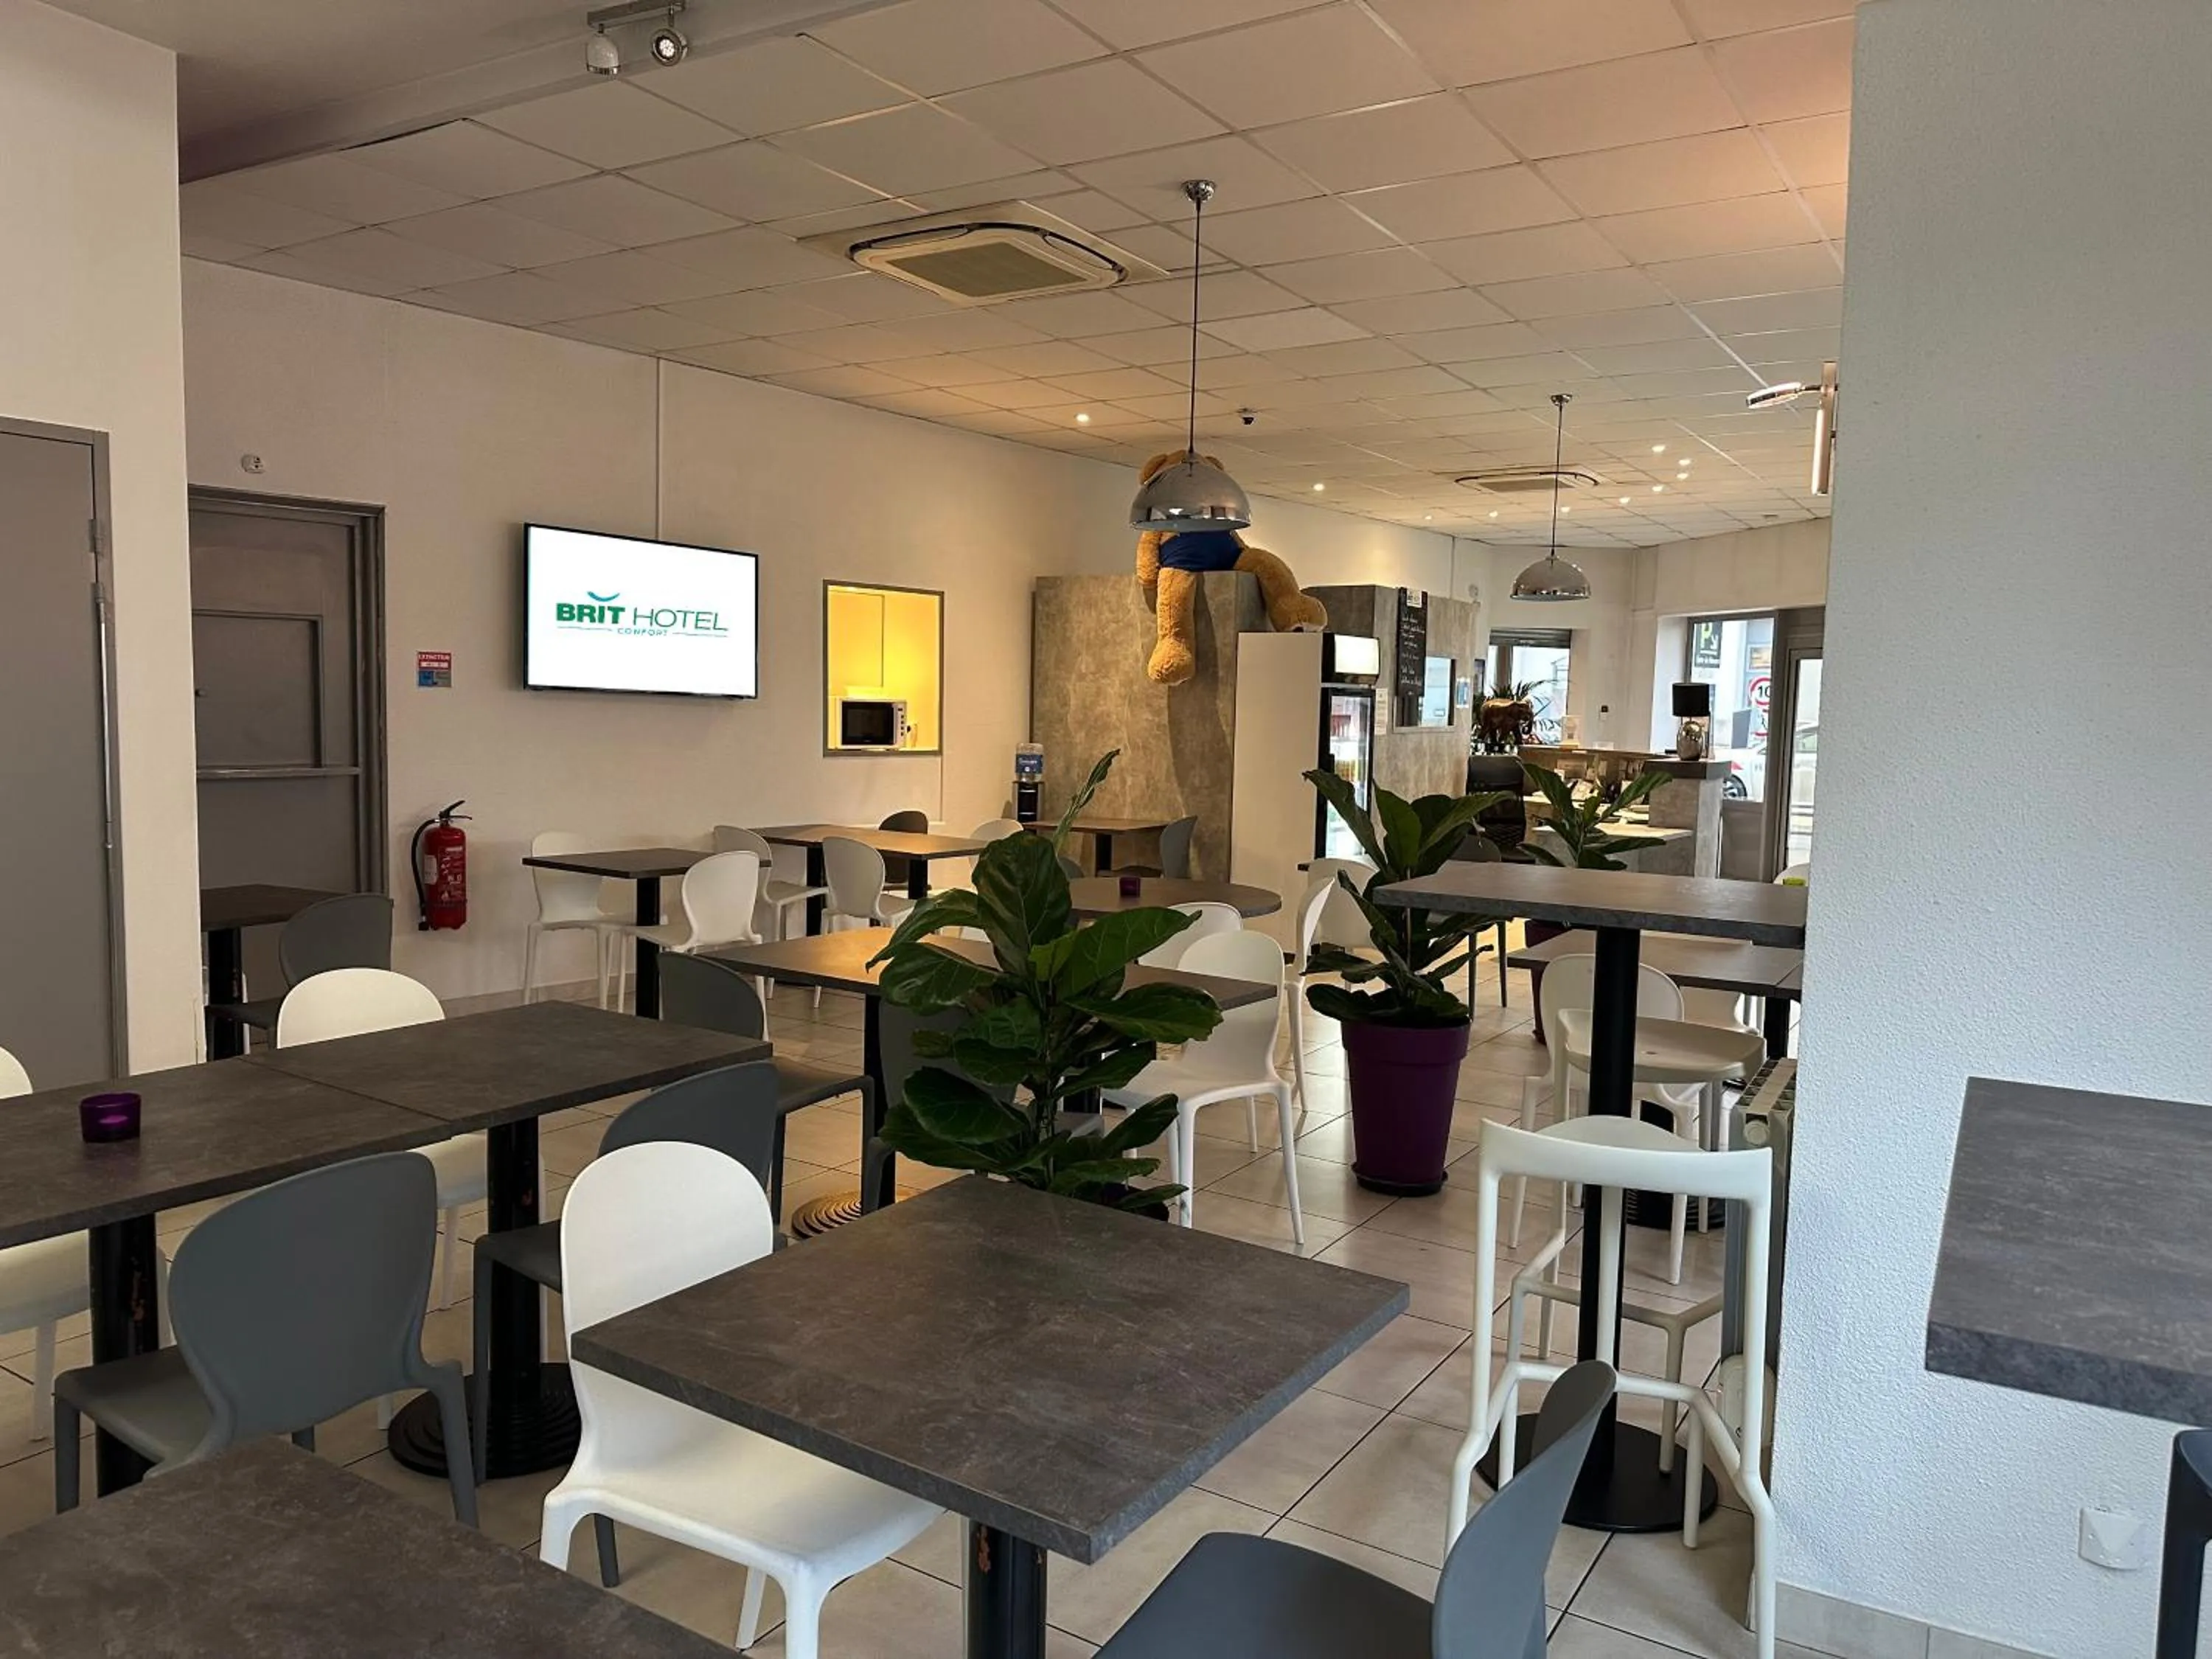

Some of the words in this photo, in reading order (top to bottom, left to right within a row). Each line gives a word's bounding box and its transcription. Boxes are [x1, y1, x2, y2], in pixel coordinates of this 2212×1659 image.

[556, 602, 625, 625] BRIT
[633, 607, 728, 631] HOTEL
[617, 627, 668, 636] CONFORT
